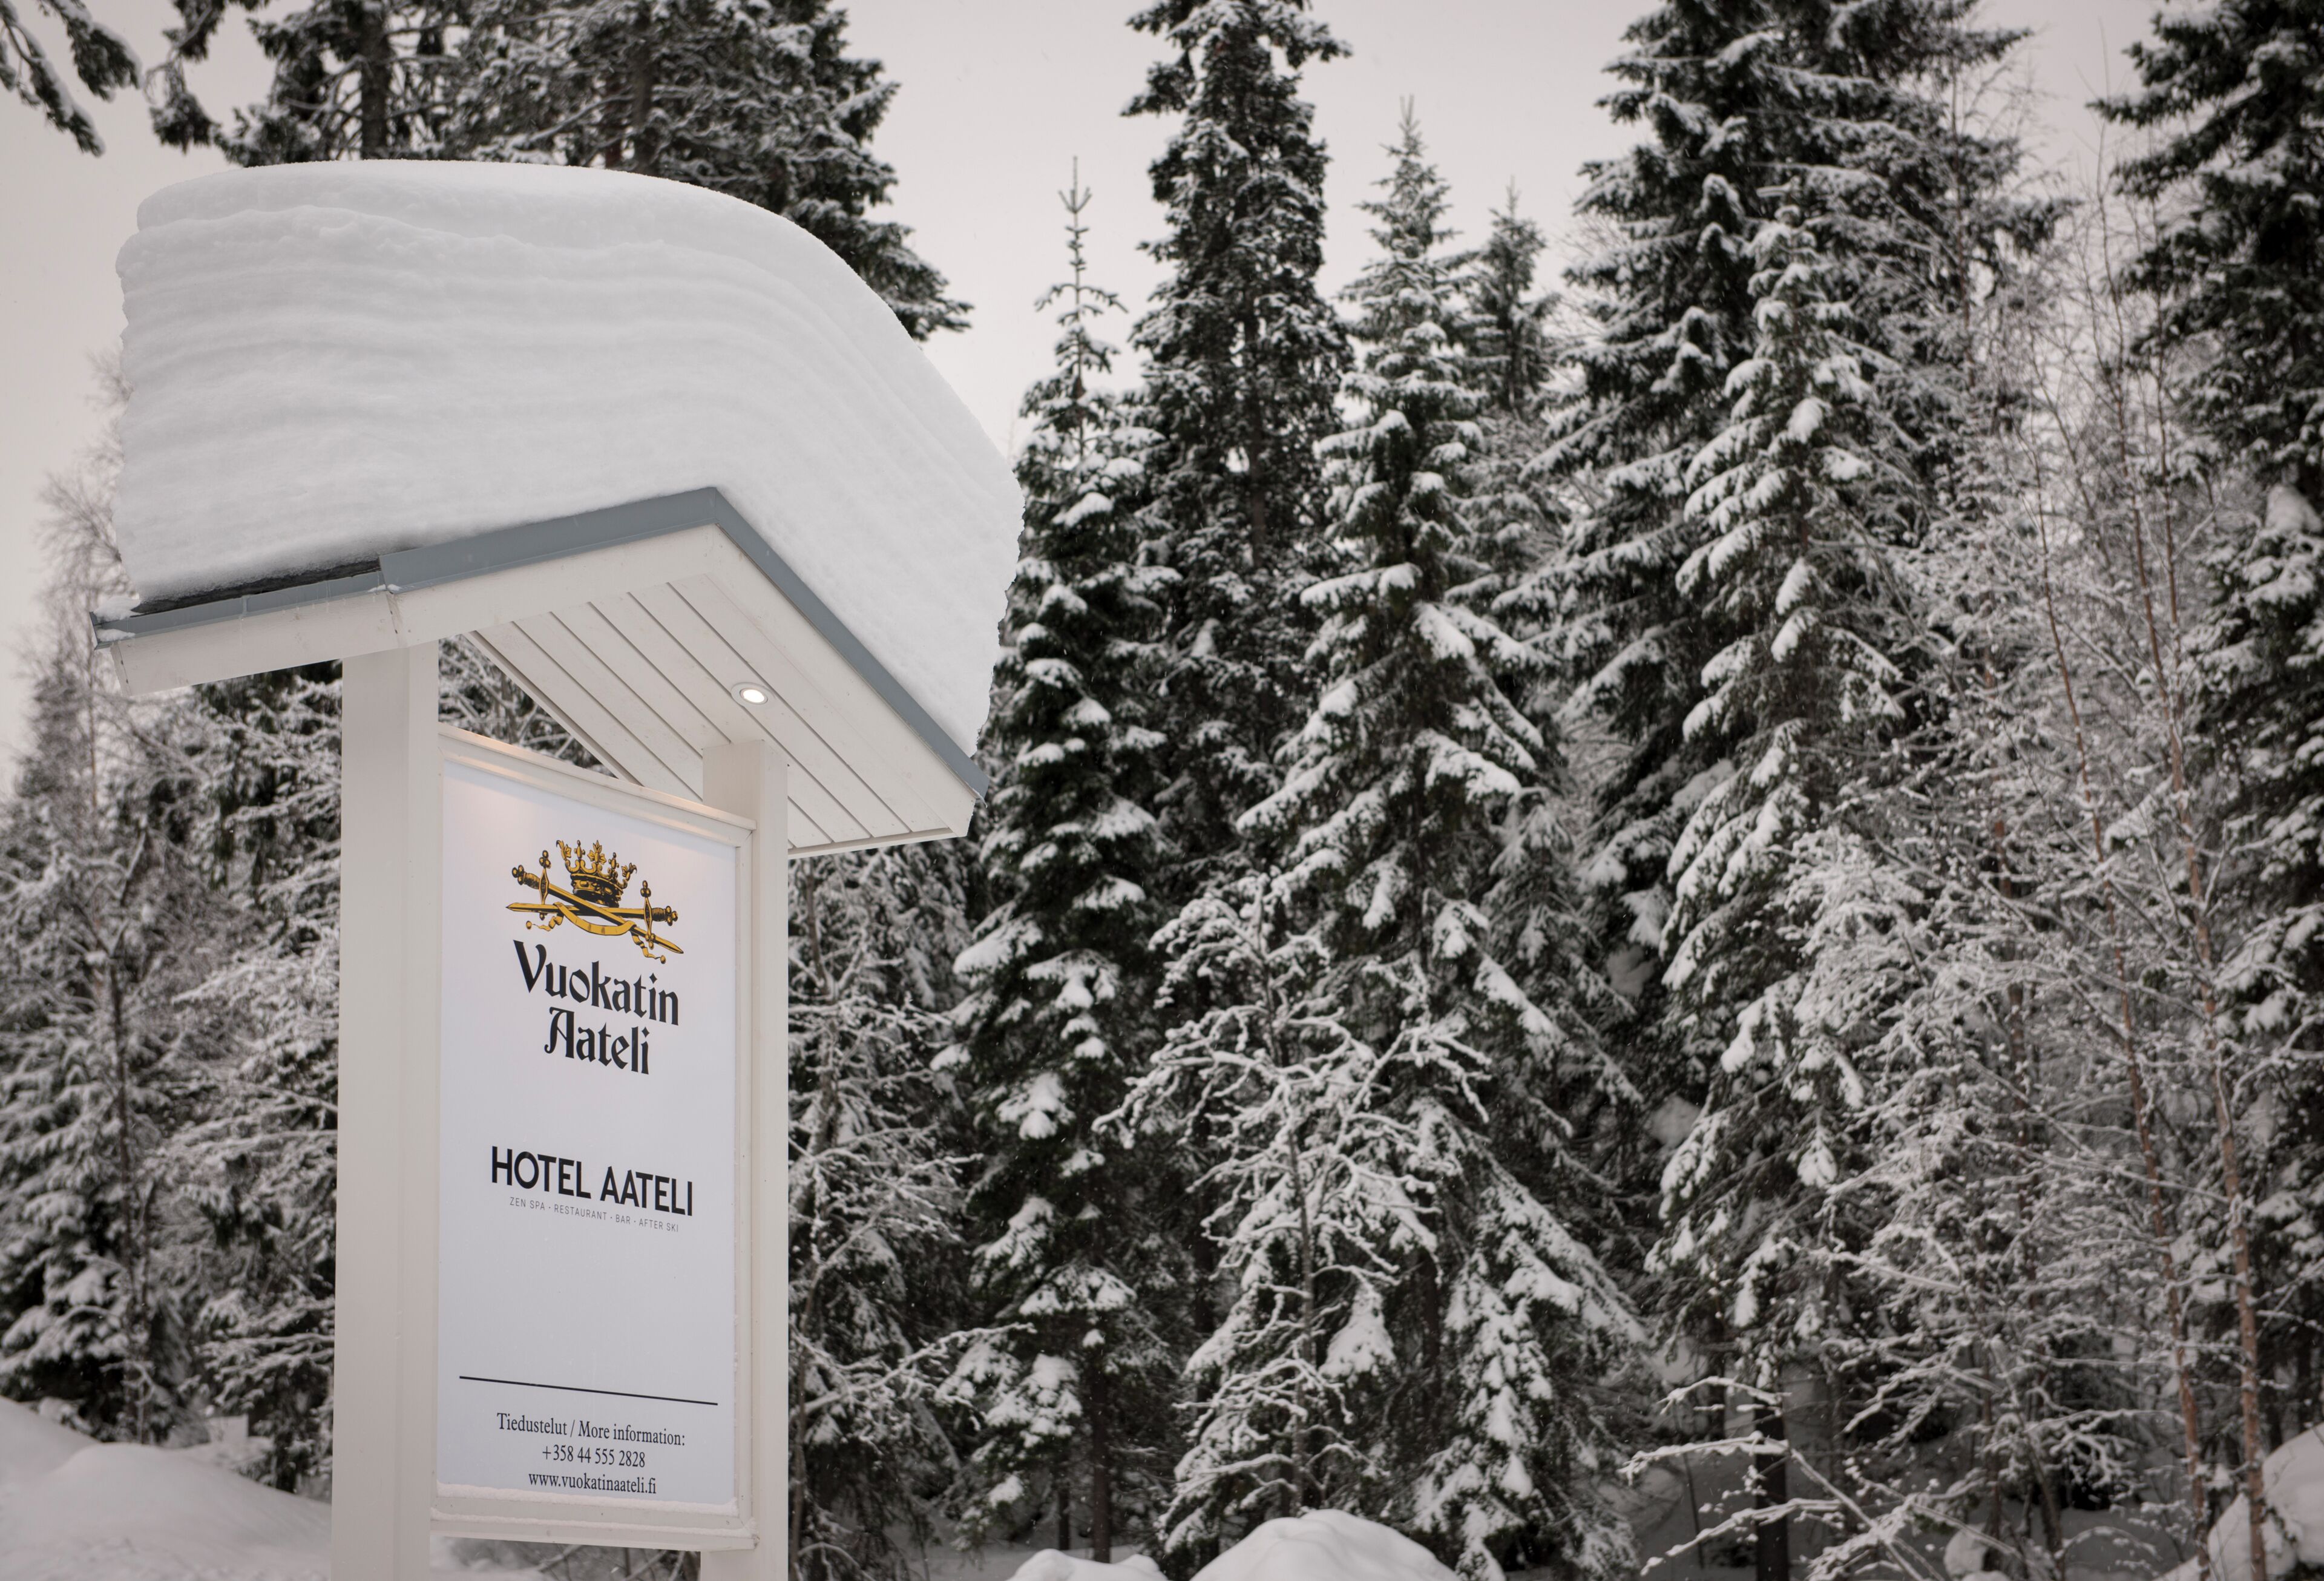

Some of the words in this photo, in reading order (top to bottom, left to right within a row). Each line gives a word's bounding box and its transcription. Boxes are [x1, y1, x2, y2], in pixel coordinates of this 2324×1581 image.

[513, 939, 678, 1025] Vuokatin
[544, 1007, 649, 1075] Aateli
[492, 1146, 591, 1199] HOTEL
[600, 1166, 692, 1216] AATELI
[510, 1197, 527, 1208] ZEN
[530, 1201, 545, 1211] SPA
[554, 1205, 607, 1221] RESTAURANT
[615, 1215, 631, 1224] BAR
[639, 1218, 663, 1230] AFTER
[666, 1223, 679, 1232] SKI
[497, 1413, 567, 1436] Tiedustelut
[570, 1419, 575, 1438] /
[579, 1421, 610, 1439] More
[613, 1424, 685, 1446] information:
[542, 1444, 574, 1461] +358
[577, 1448, 591, 1464] 44
[595, 1448, 614, 1465] 555
[619, 1451, 645, 1468] 2828
[528, 1472, 657, 1494] www.vuokatinaateli.fi
